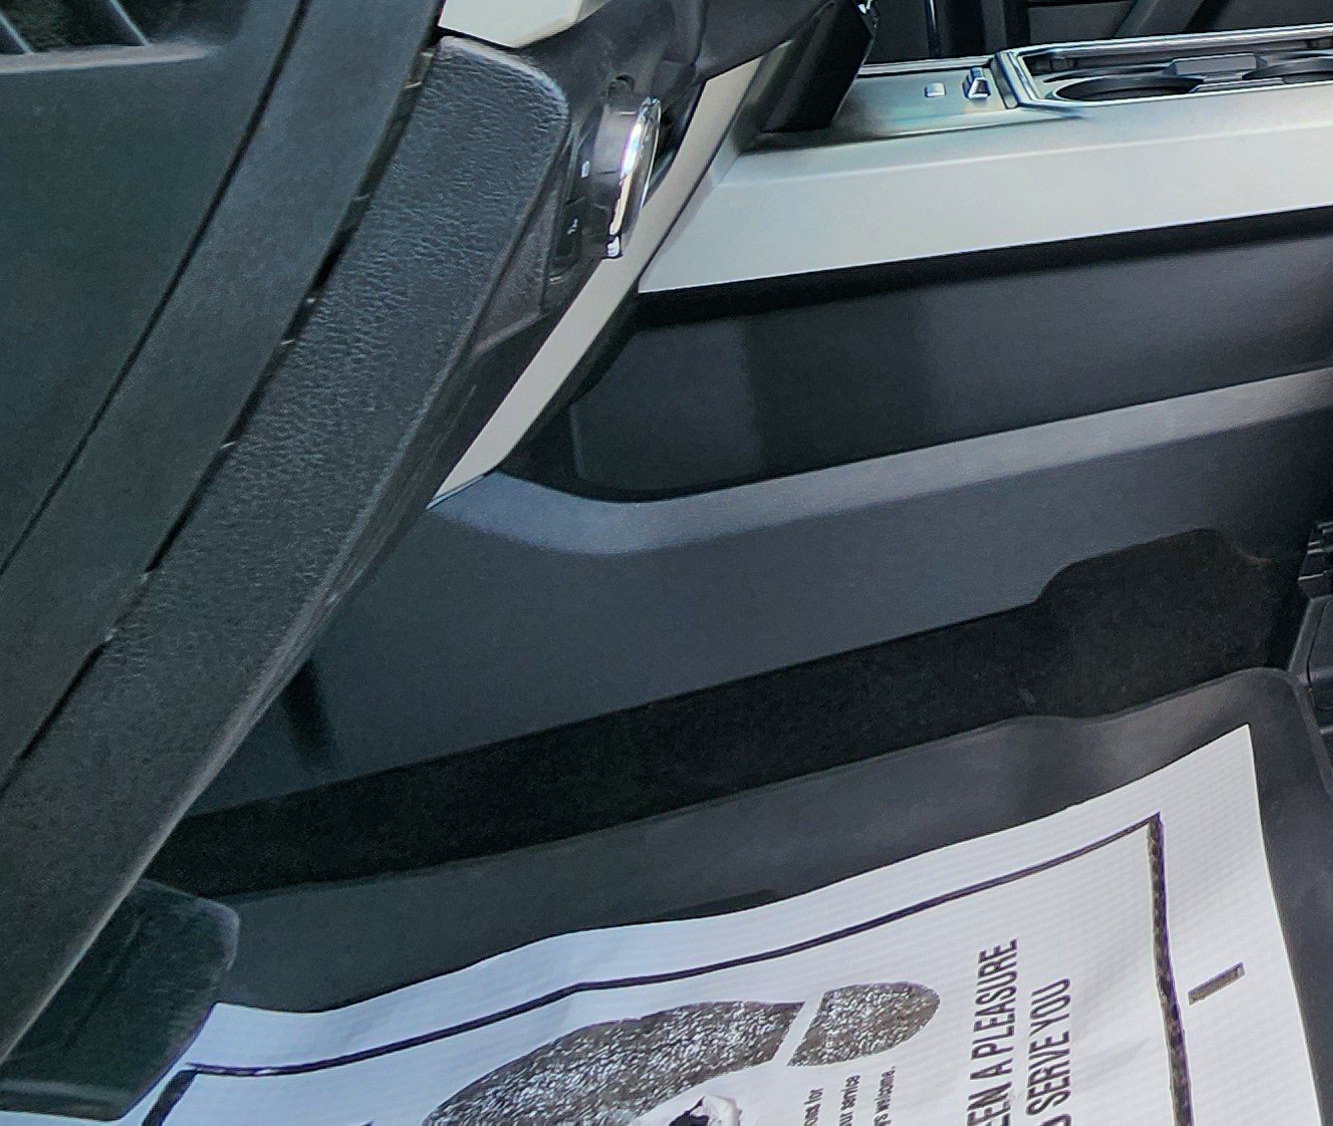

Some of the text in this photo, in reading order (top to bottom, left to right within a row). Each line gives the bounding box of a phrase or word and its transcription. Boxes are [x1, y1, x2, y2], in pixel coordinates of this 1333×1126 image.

[971, 938, 1018, 1060] PLEASURE
[1029, 977, 1071, 1037] YOU
[840, 1075, 861, 1111] service
[874, 1065, 896, 1114] welcome.
[970, 1058, 1013, 1080] A
[1026, 1031, 1071, 1116] SERVE
[804, 1087, 824, 1105] for
